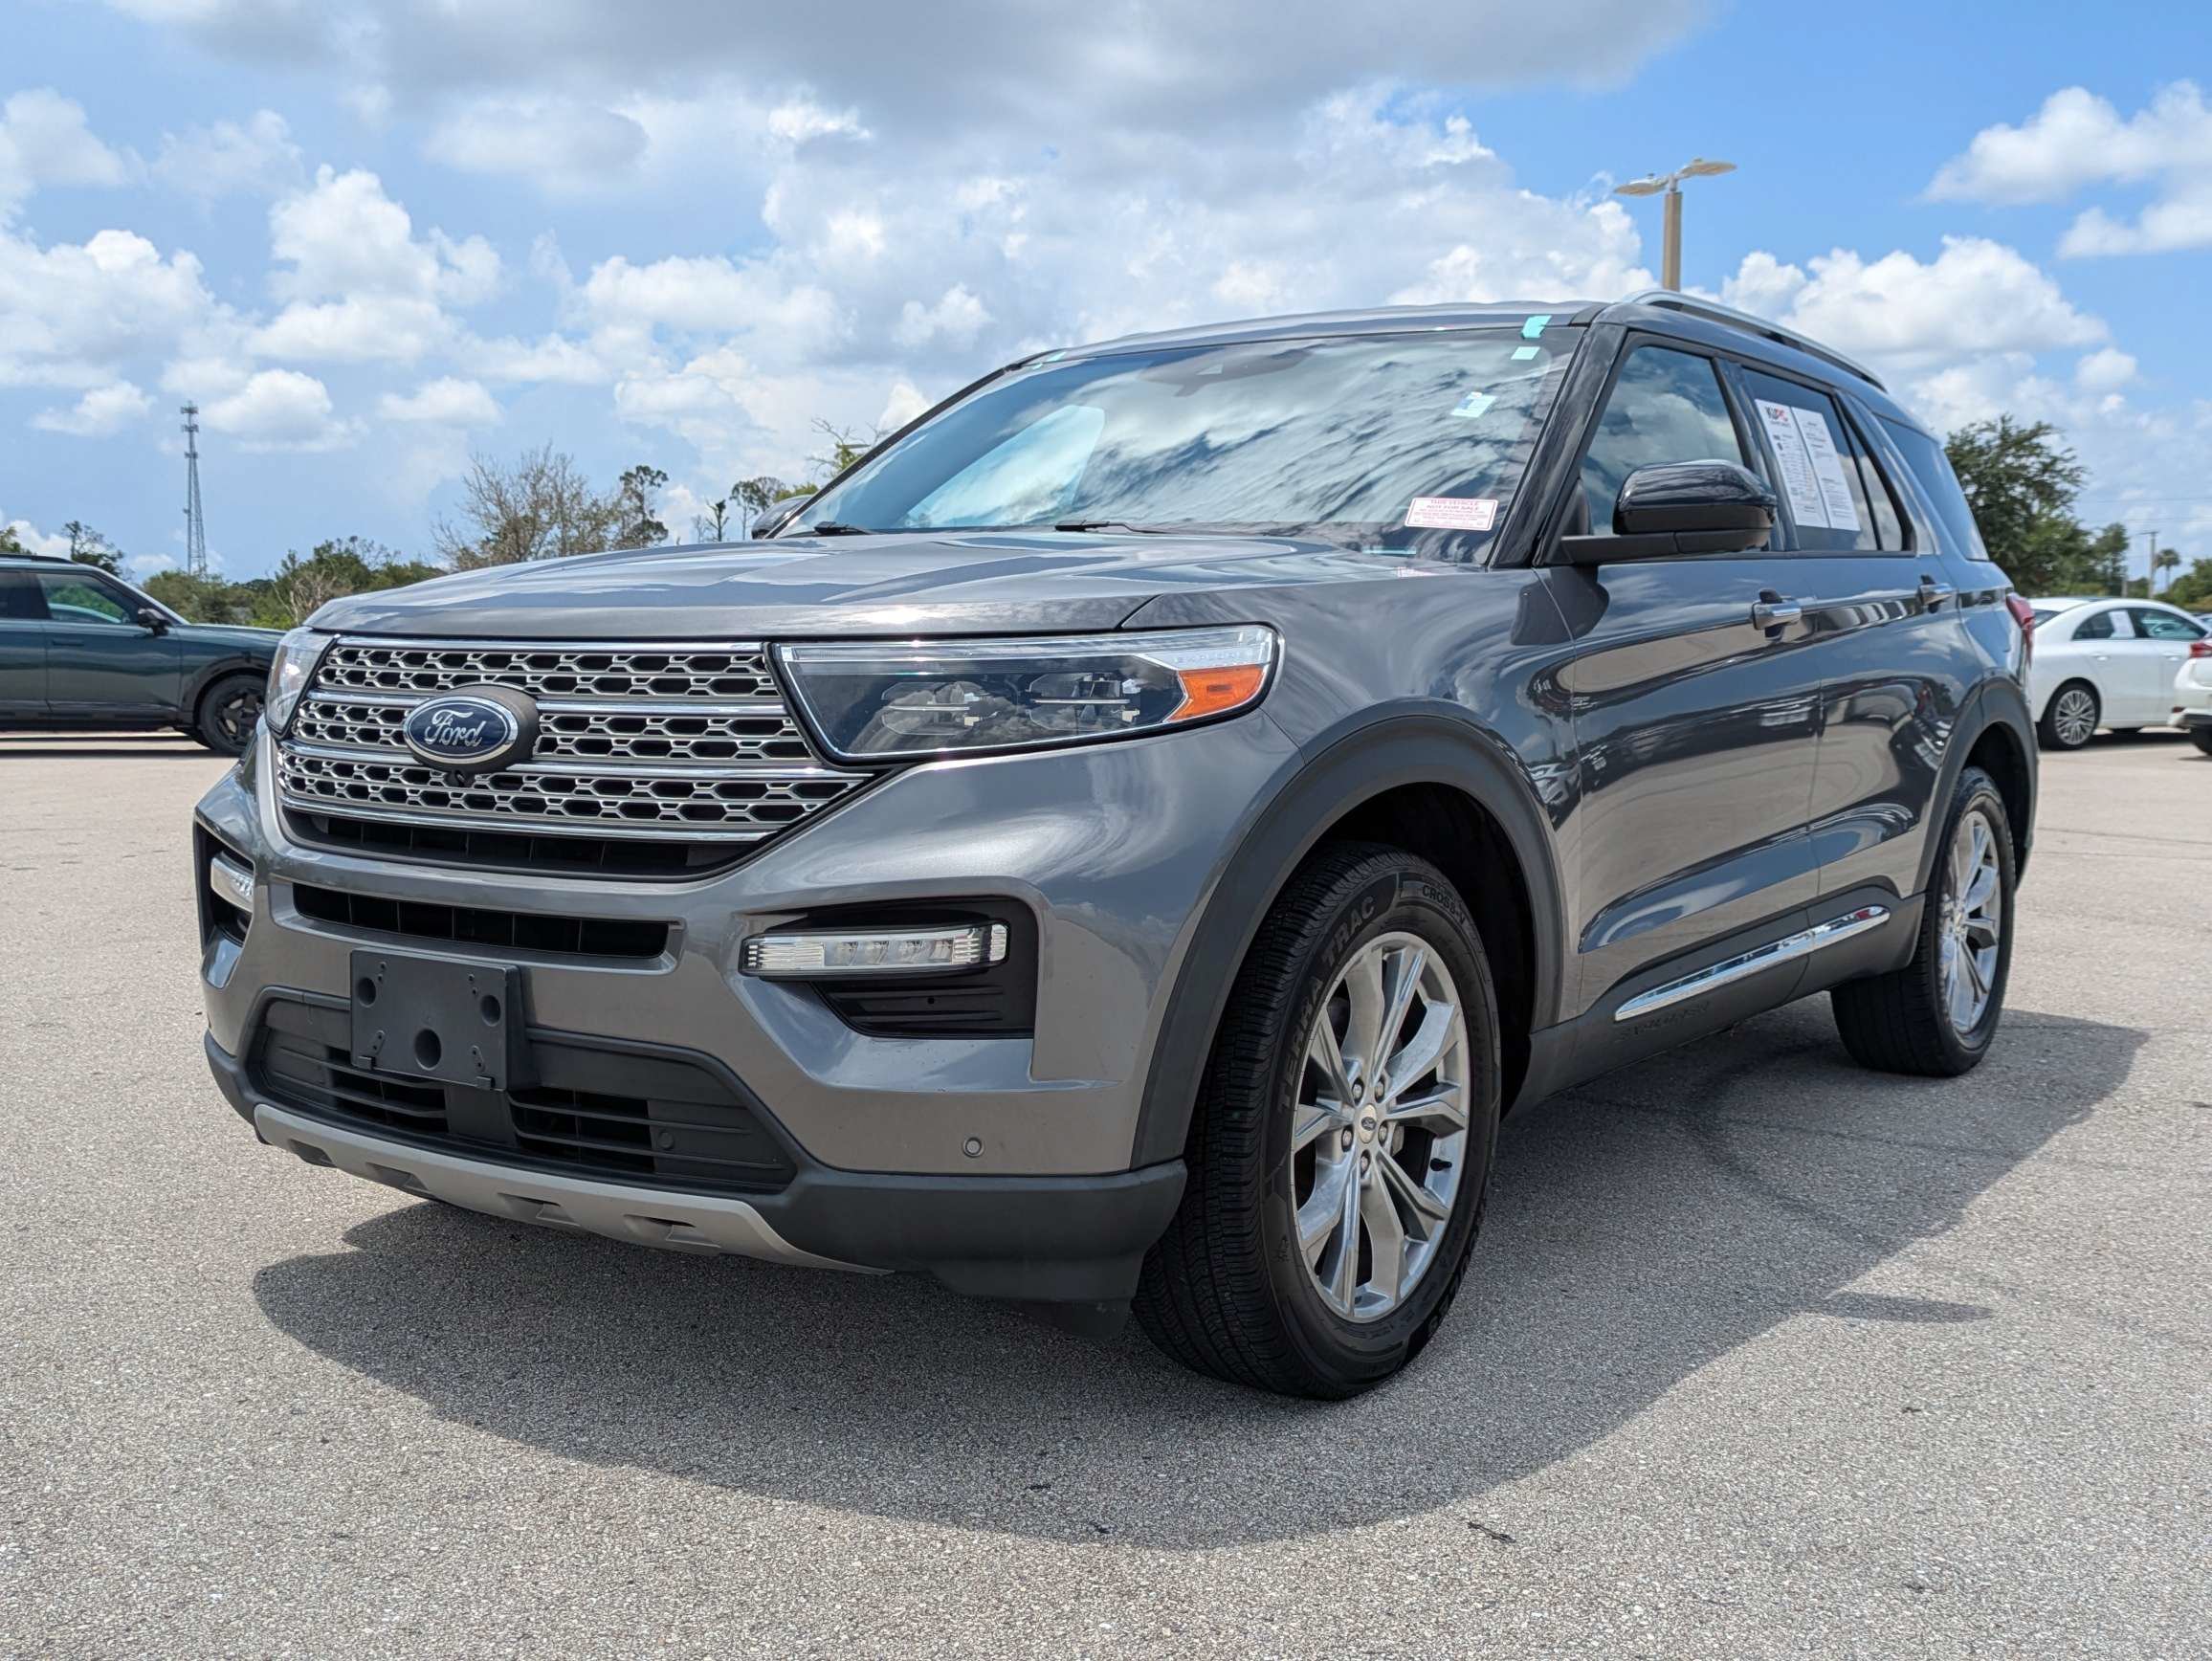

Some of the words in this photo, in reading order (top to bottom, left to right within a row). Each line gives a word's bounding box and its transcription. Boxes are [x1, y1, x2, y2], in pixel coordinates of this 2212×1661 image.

[424, 709, 487, 746] Ford
[1422, 884, 1466, 925] CROSS-V
[1277, 976, 1324, 1114] TERRA
[1322, 895, 1376, 967] TRAC
